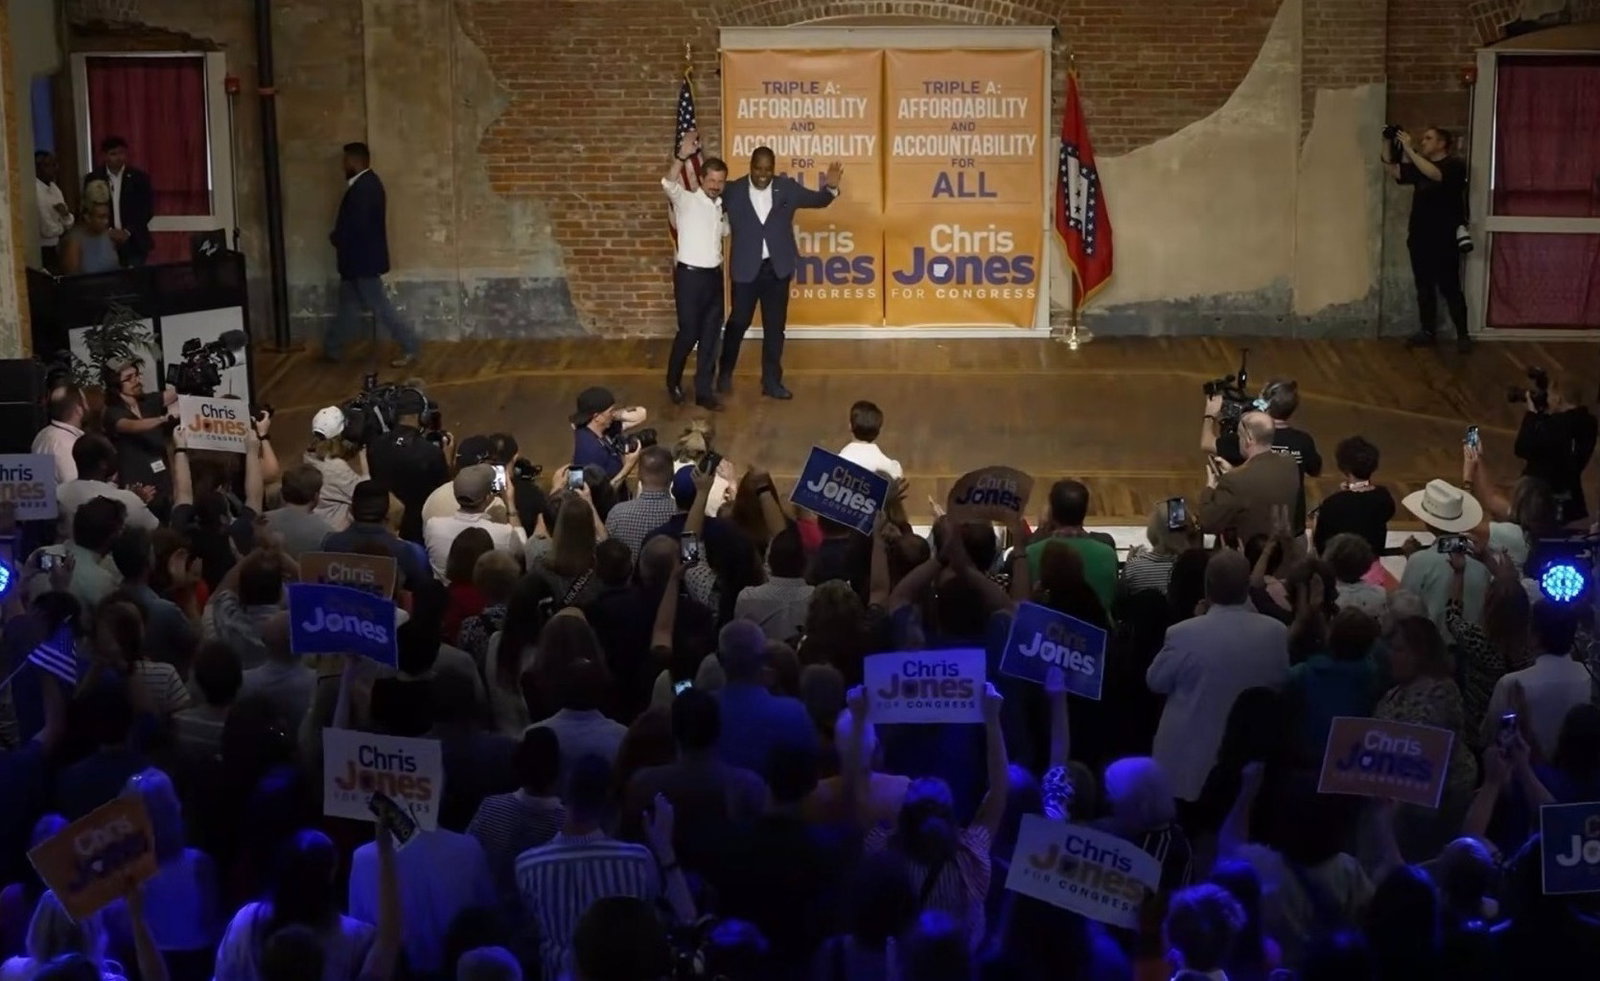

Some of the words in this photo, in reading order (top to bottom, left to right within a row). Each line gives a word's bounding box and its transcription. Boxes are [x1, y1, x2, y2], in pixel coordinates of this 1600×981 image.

[762, 81, 820, 95] TRIPLE
[823, 81, 841, 95] A:
[922, 81, 981, 95] TRIPLE
[984, 81, 1002, 95] A:
[737, 98, 868, 119] AFFORDABILITY
[898, 97, 1028, 119] AFFORDABILITY
[790, 121, 816, 132] AND
[950, 121, 976, 132] AND
[892, 134, 1037, 157] ACCOUNTABILITY
[791, 158, 815, 169] FOR
[951, 158, 975, 169] FOR
[931, 171, 998, 198] ALL
[793, 224, 855, 253] hris
[929, 224, 1014, 254] Chris
[796, 254, 876, 286] nes
[892, 246, 1036, 286] Jones
[790, 288, 877, 299] ONGRESS
[891, 288, 925, 299] FOR
[935, 288, 1036, 300] CONGRESS
[201, 404, 236, 420] Chris
[187, 414, 247, 436] Jones
[0, 464, 33, 481] hris
[832, 466, 871, 496] Chris
[806, 472, 877, 515] Jones
[955, 486, 1022, 512] Jones
[327, 561, 375, 583] Chris
[301, 606, 389, 645] Jones
[1018, 631, 1096, 676] Jones
[903, 660, 960, 678] Chris
[877, 673, 974, 700] Jones
[906, 700, 976, 709] CONGRESS
[1364, 730, 1422, 756] Chris
[358, 744, 417, 773] Chris
[1065, 834, 1134, 873] Chris
